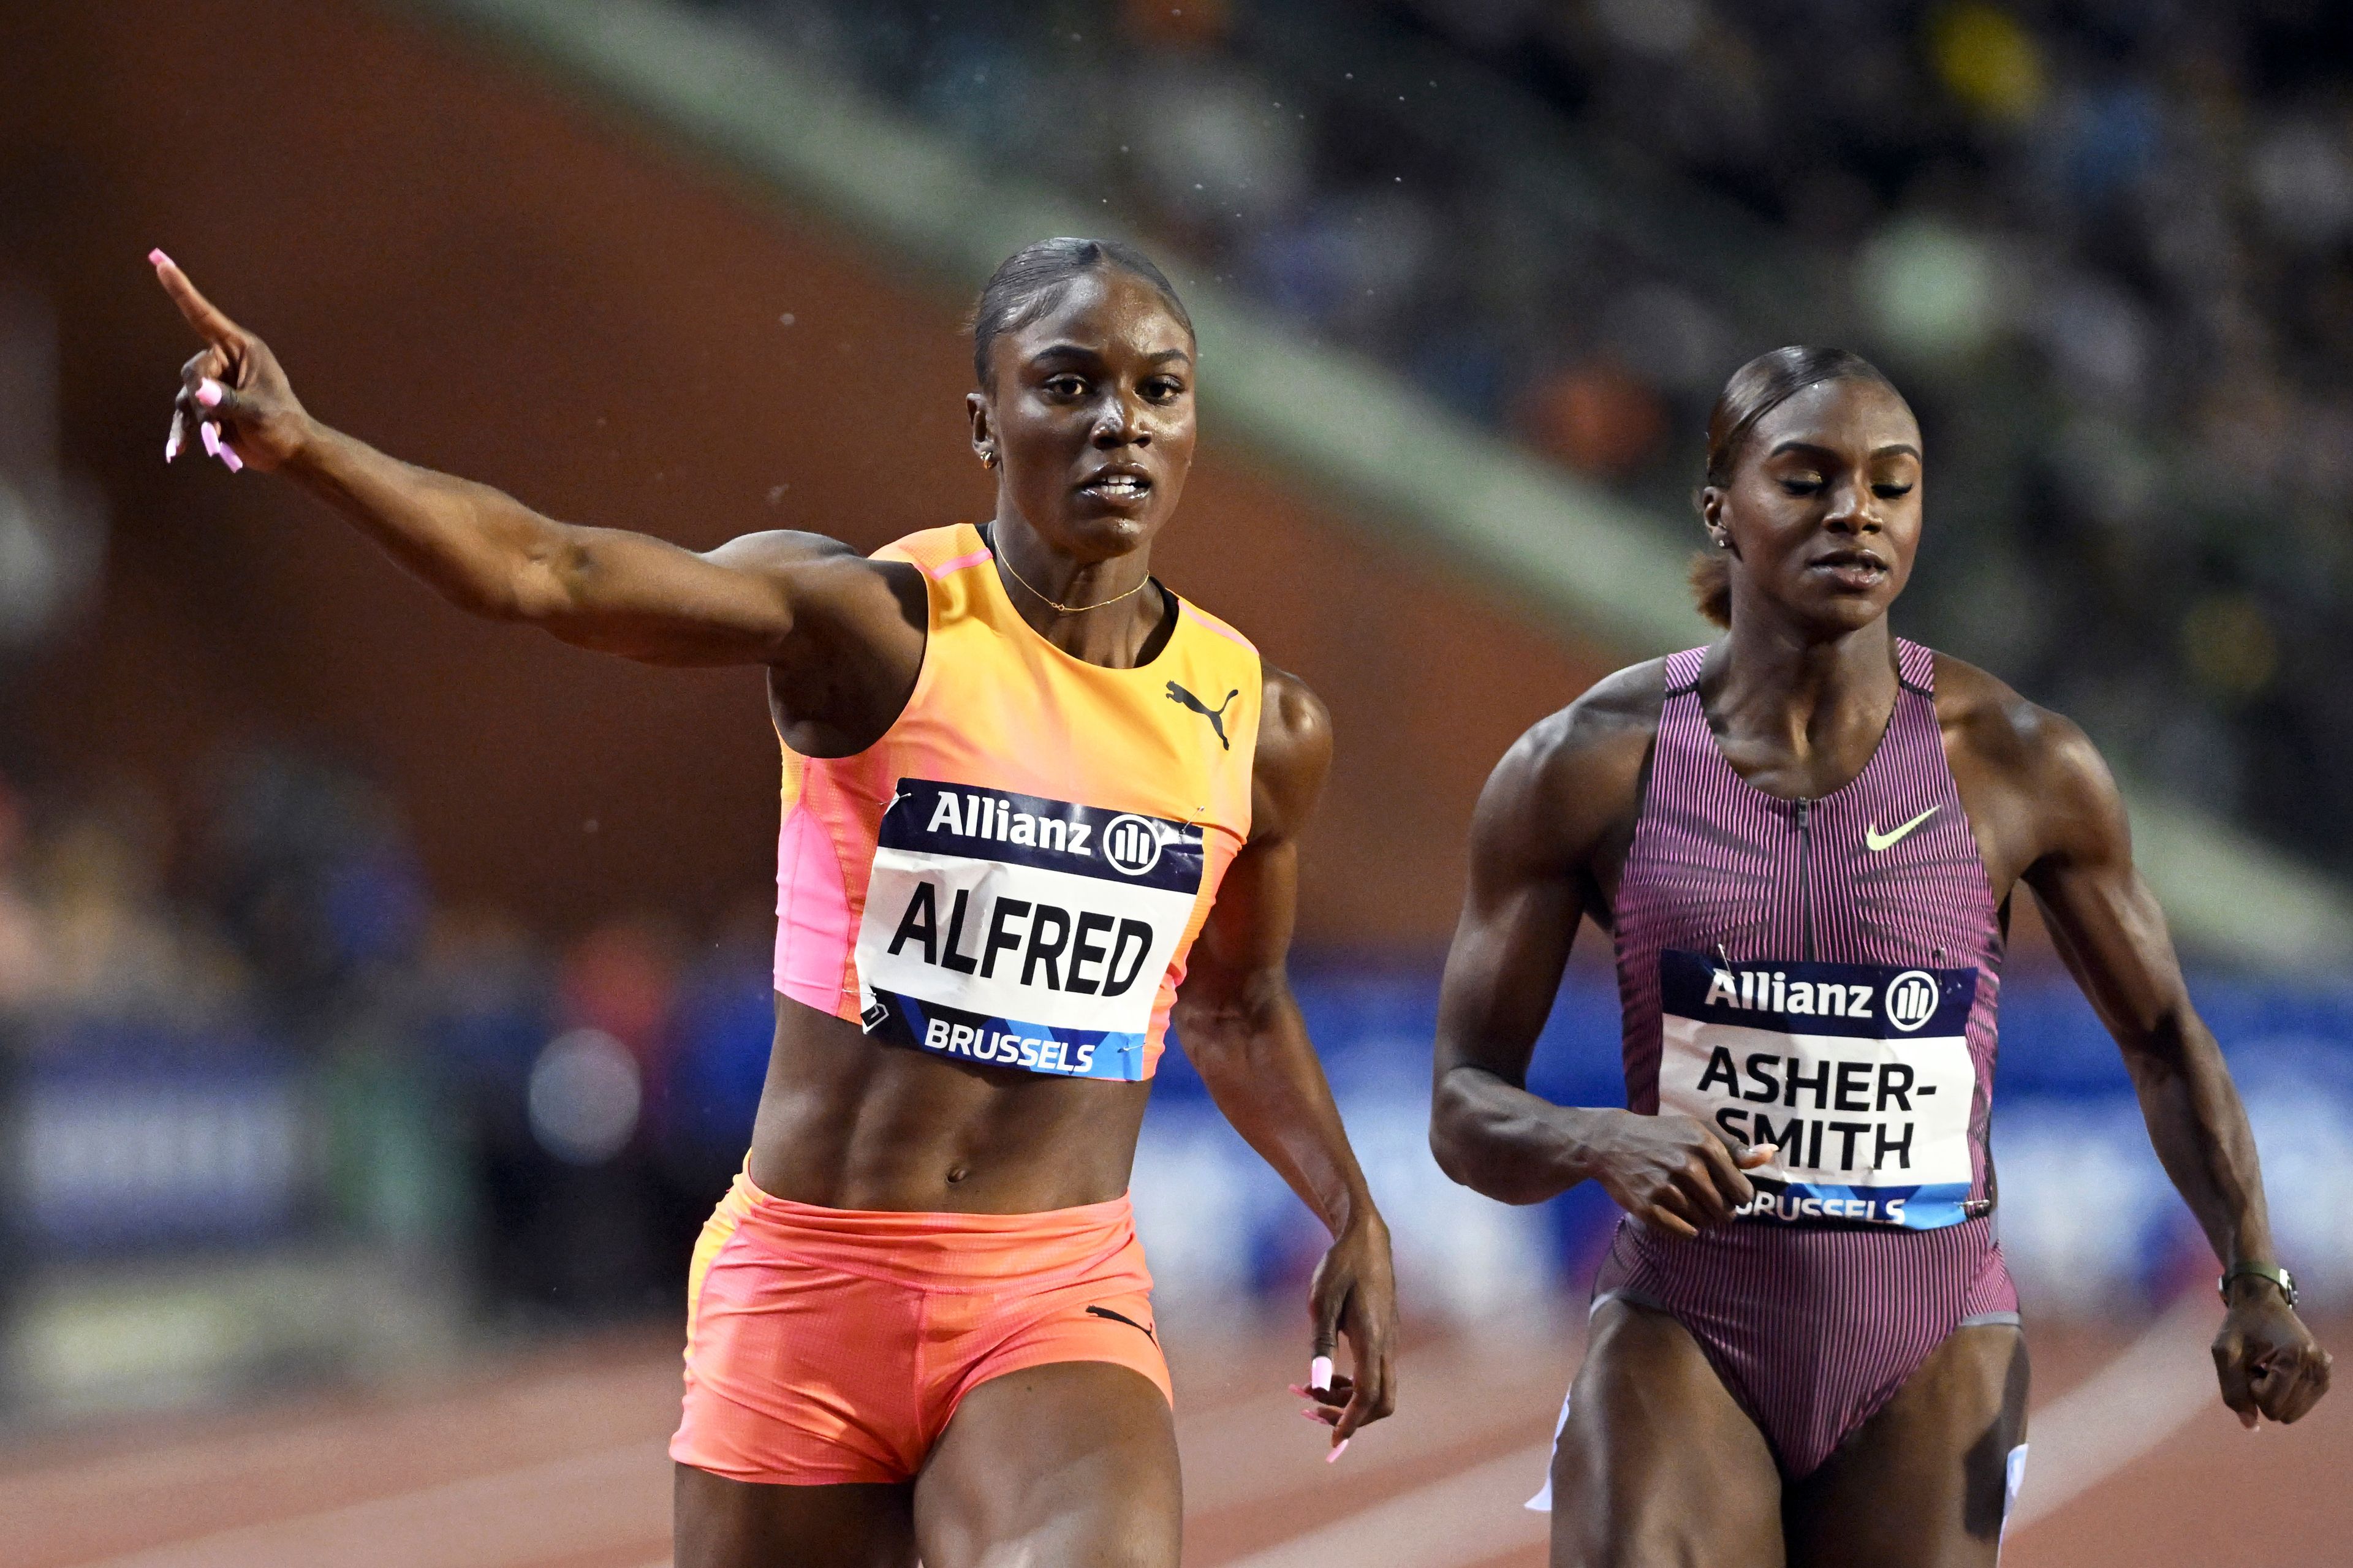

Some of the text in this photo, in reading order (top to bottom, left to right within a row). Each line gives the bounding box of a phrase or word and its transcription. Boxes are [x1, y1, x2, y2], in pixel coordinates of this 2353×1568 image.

[927, 791, 1092, 855] Allianz
[887, 881, 1153, 997] ALFRED
[1705, 968, 1873, 1018] Allianz
[925, 1018, 1095, 1072] BRUSSELS
[1697, 1045, 1936, 1112] ASHER-
[1716, 1107, 1914, 1170] SMITH
